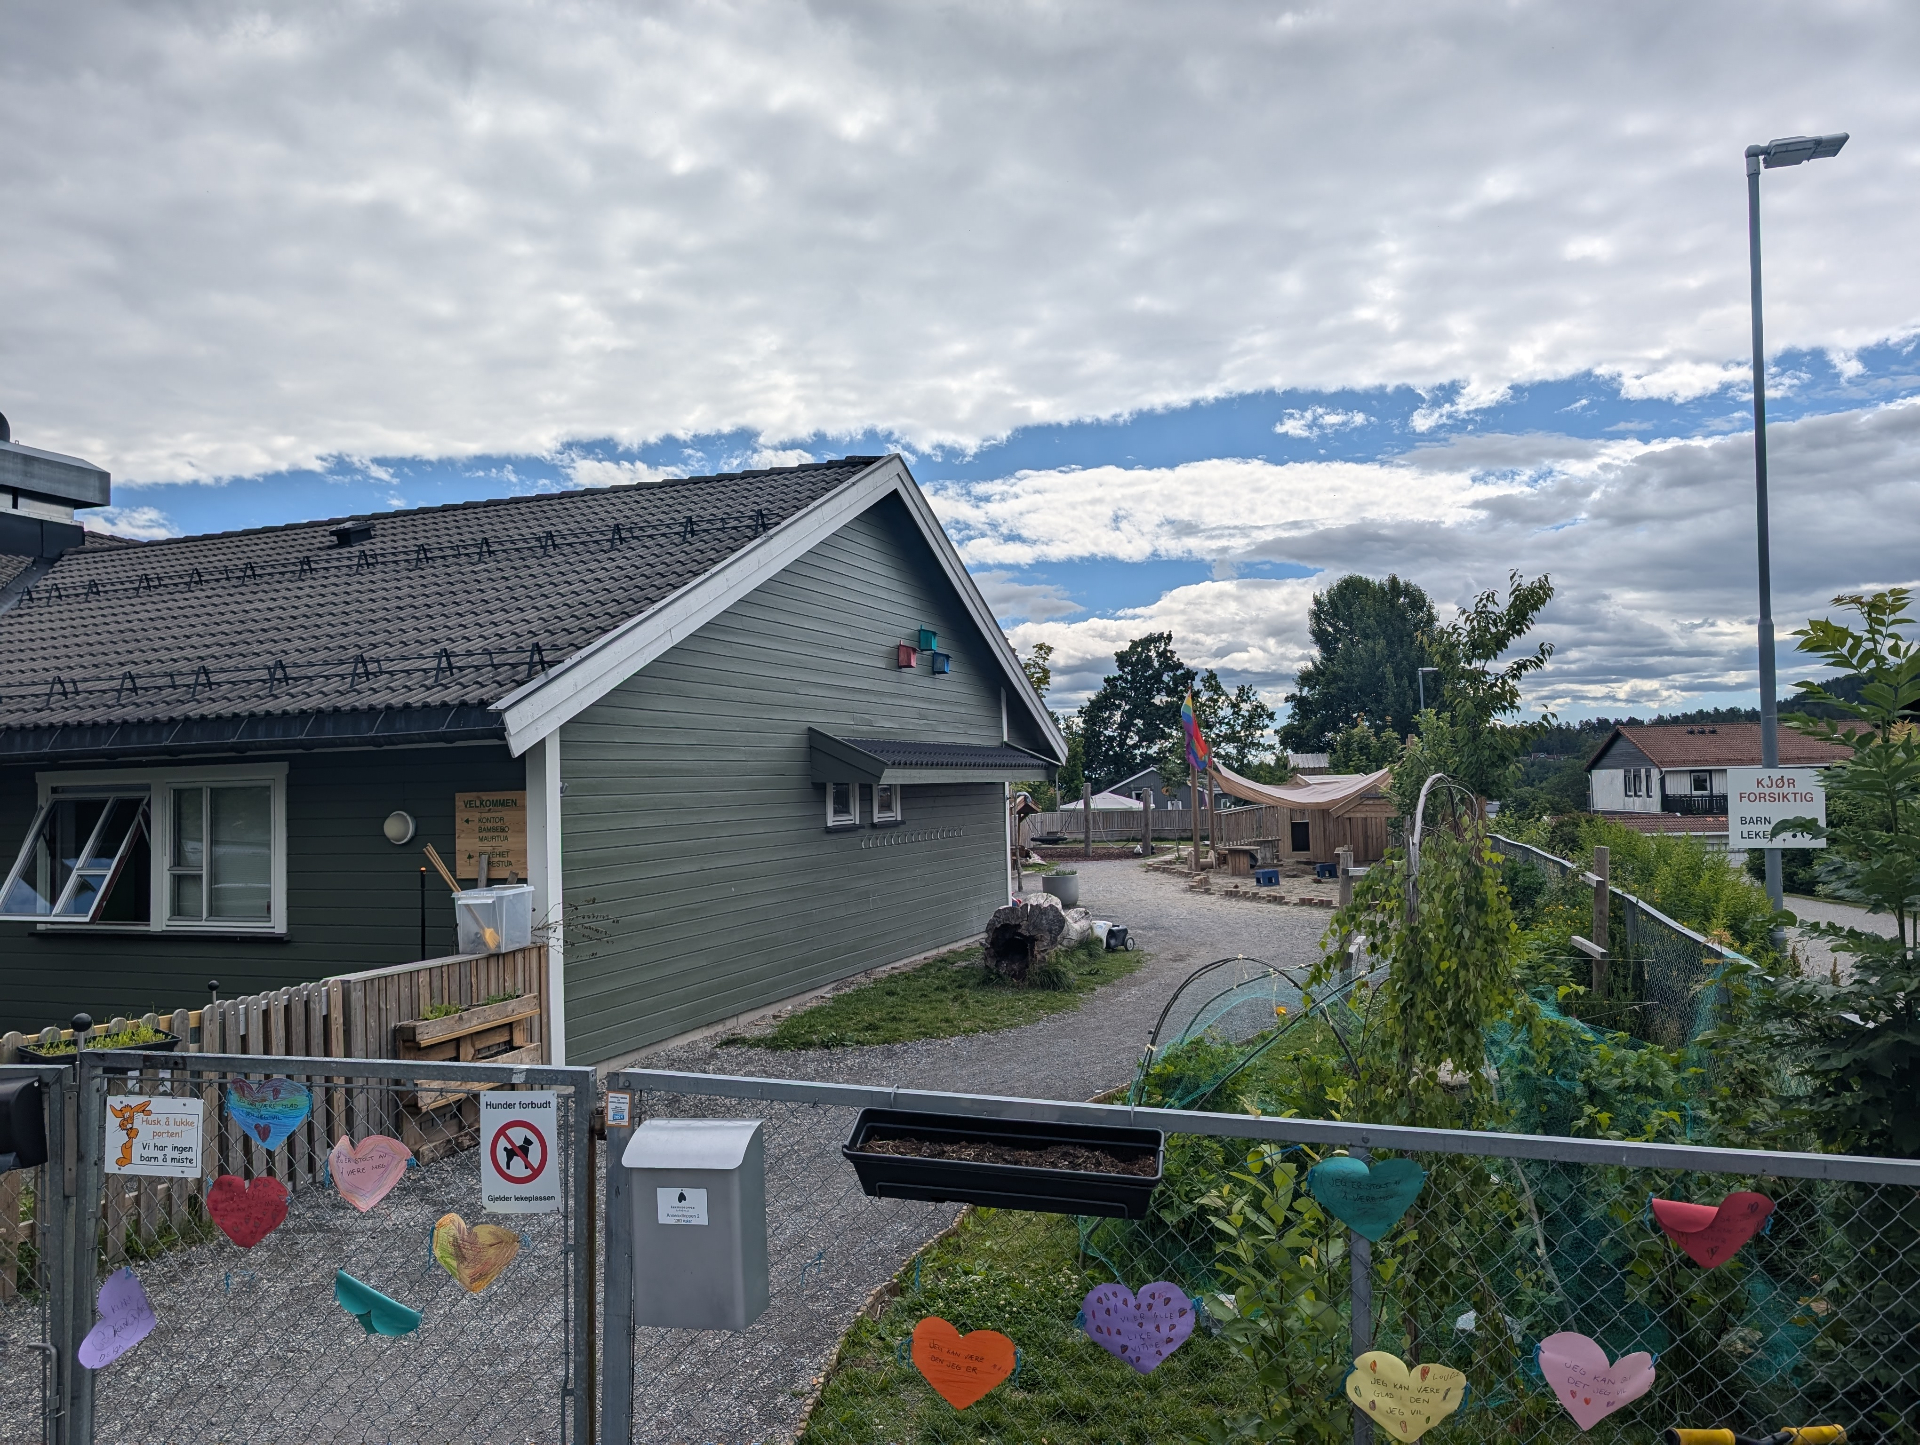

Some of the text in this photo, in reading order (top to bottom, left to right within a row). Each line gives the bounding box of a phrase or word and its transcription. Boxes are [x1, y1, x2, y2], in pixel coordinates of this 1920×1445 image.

[1756, 777, 1796, 789] KJØR
[1739, 792, 1814, 803] FORSIKTIG
[463, 798, 517, 808] VELKOMMEN
[478, 816, 505, 824] KONTOR
[1740, 816, 1771, 825] BARN
[1740, 830, 1776, 840] LEKE
[486, 1100, 551, 1109] Hunder forbudt
[141, 1117, 195, 1127] Husk å lukke
[152, 1130, 183, 1139] porten!
[142, 1142, 193, 1154] Vi har ingen
[140, 1153, 194, 1164] barn å miste
[1329, 1177, 1347, 1188] JEG
[487, 1194, 556, 1203] Gjelder lekeplassen
[946, 1347, 961, 1357] KAN
[964, 1354, 985, 1363] VÆRE
[930, 1355, 978, 1375] DEN JEG ER
[1564, 1360, 1587, 1376] JEG
[1593, 1374, 1615, 1385] KAN
[1370, 1378, 1440, 1394] JEG KAN VÆRE
[1567, 1376, 1590, 1389] DET
[1593, 1388, 1611, 1396] JEG
[1373, 1390, 1394, 1399] GLAD
[1386, 1407, 1404, 1416] JEG
